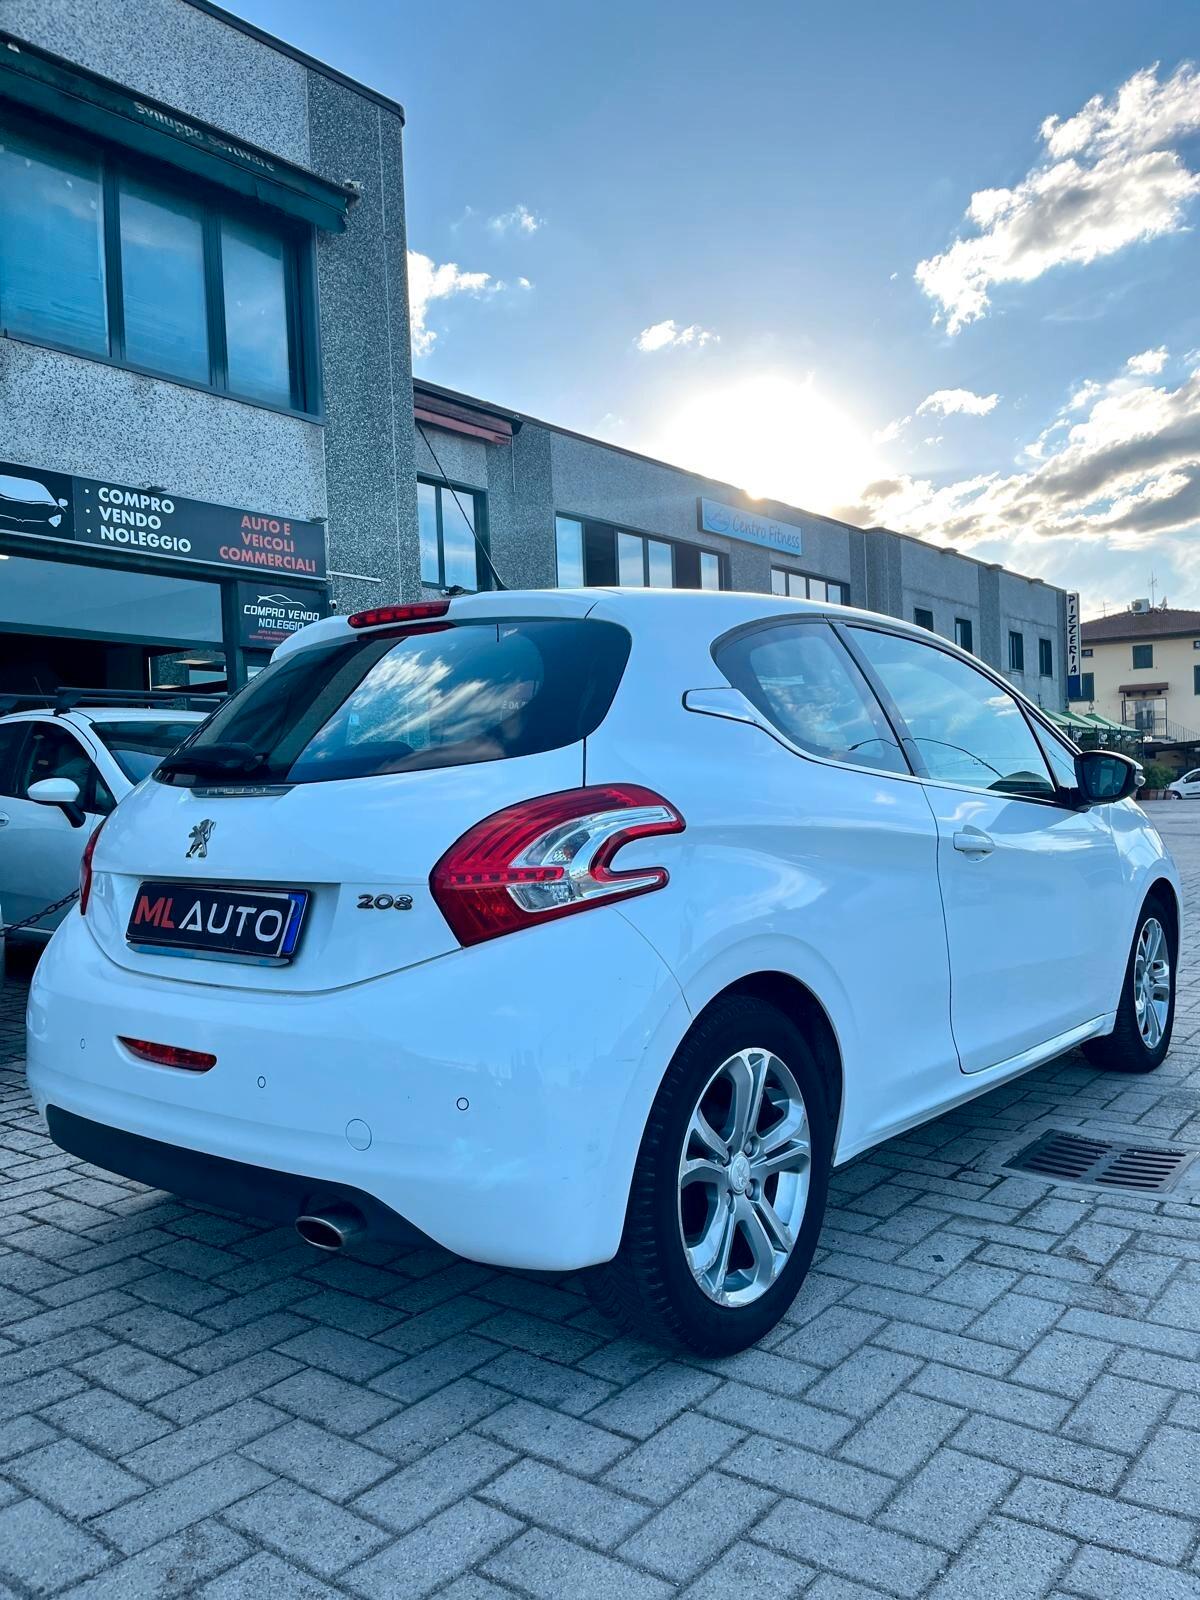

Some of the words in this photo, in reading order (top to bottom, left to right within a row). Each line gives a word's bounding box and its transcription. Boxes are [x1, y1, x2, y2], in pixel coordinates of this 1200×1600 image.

[98, 487, 175, 514] COMPRO
[98, 505, 161, 529] VENDO
[241, 515, 280, 534] AUTO
[284, 523, 291, 536] E
[101, 525, 191, 553] NOLEGGIO
[241, 532, 294, 553] VEICOLI
[732, 515, 766, 538] Centro
[769, 526, 800, 548] Fitness
[219, 546, 316, 573] COMMERCIALI
[243, 605, 285, 618] COMPRO
[288, 609, 320, 621] VENDO
[258, 618, 305, 631] NOLEGGIO
[1068, 595, 1077, 674] PIZZERIA
[357, 894, 414, 911] 208
[134, 895, 174, 929] ML
[178, 900, 283, 942] AUTO
